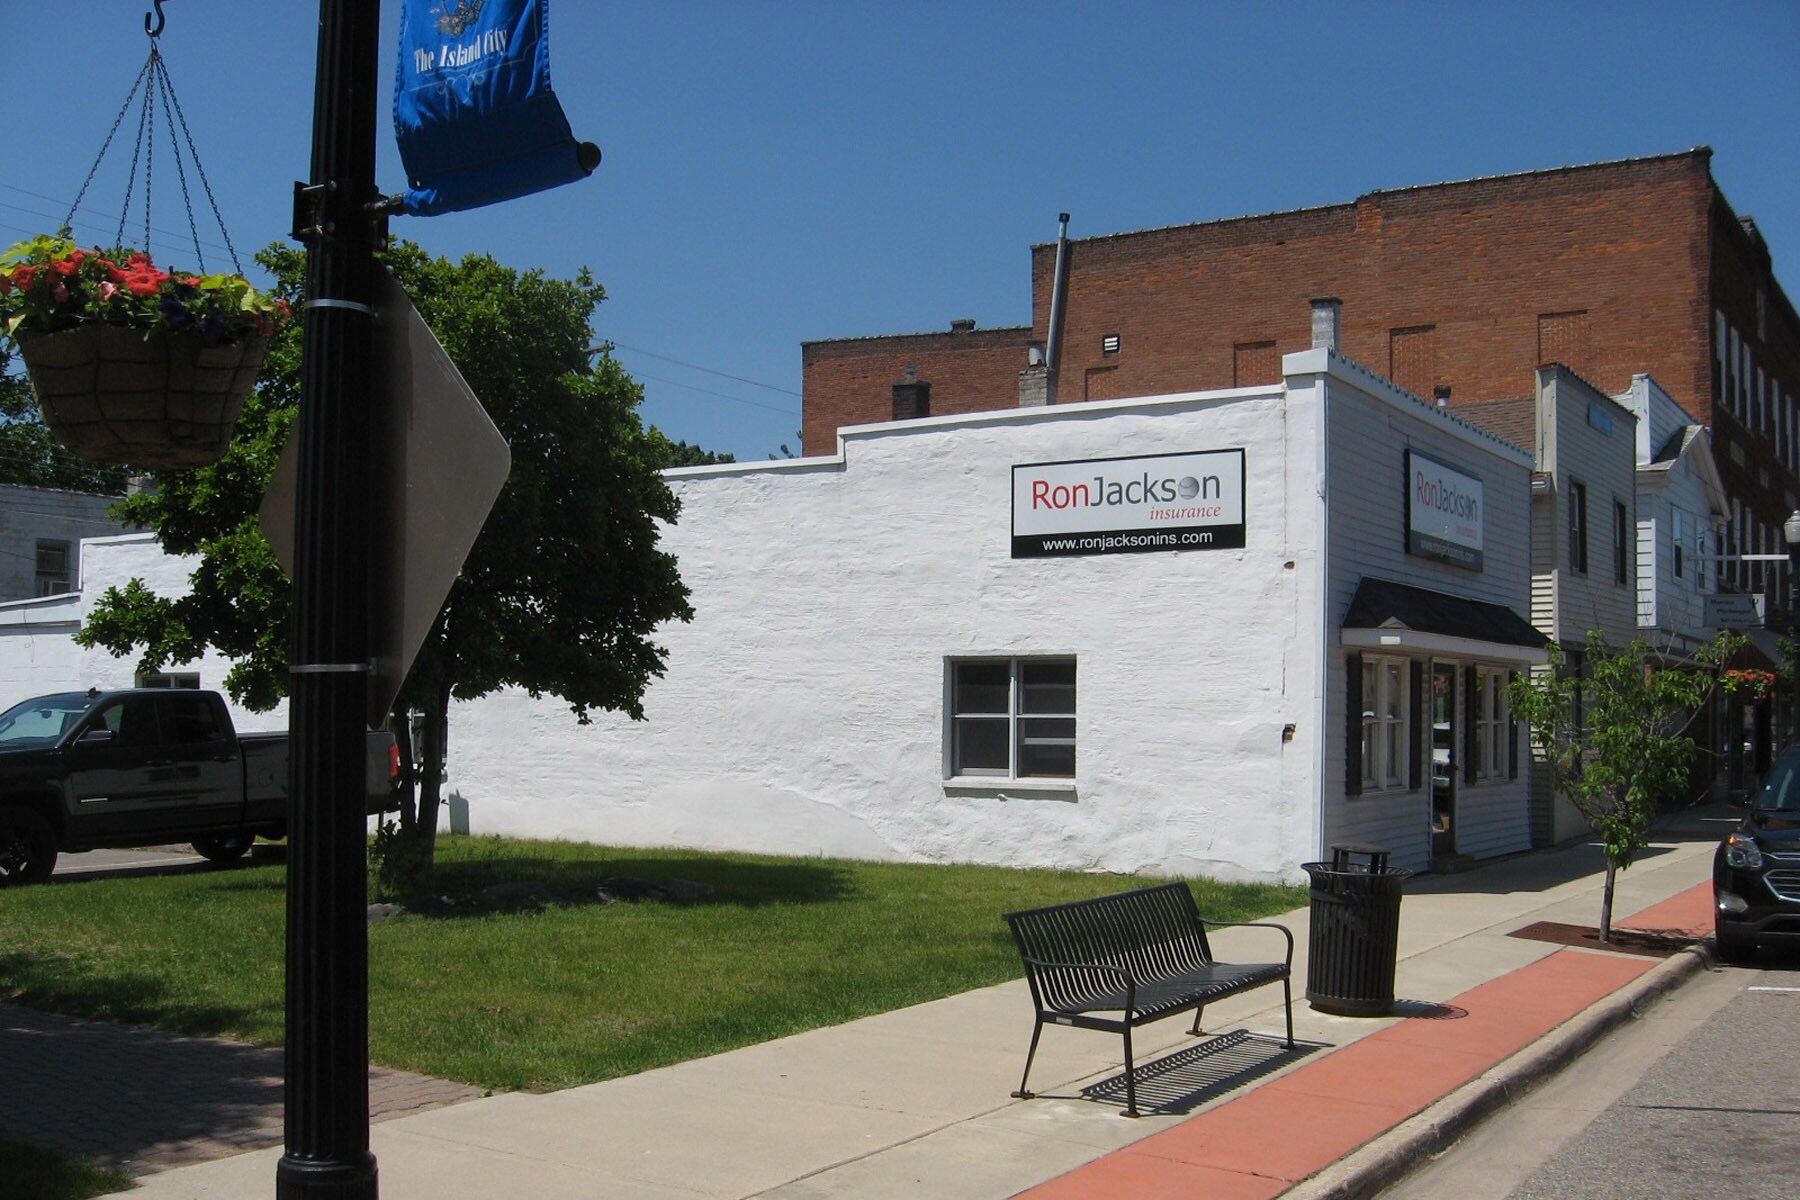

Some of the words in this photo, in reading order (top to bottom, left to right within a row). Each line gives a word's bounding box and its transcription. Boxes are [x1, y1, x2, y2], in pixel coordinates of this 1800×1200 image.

[414, 48, 435, 74] The
[439, 35, 481, 68] Island
[483, 28, 507, 56] City
[1150, 505, 1222, 520] insurance
[1042, 531, 1213, 551] www.ronjacksonins.com
